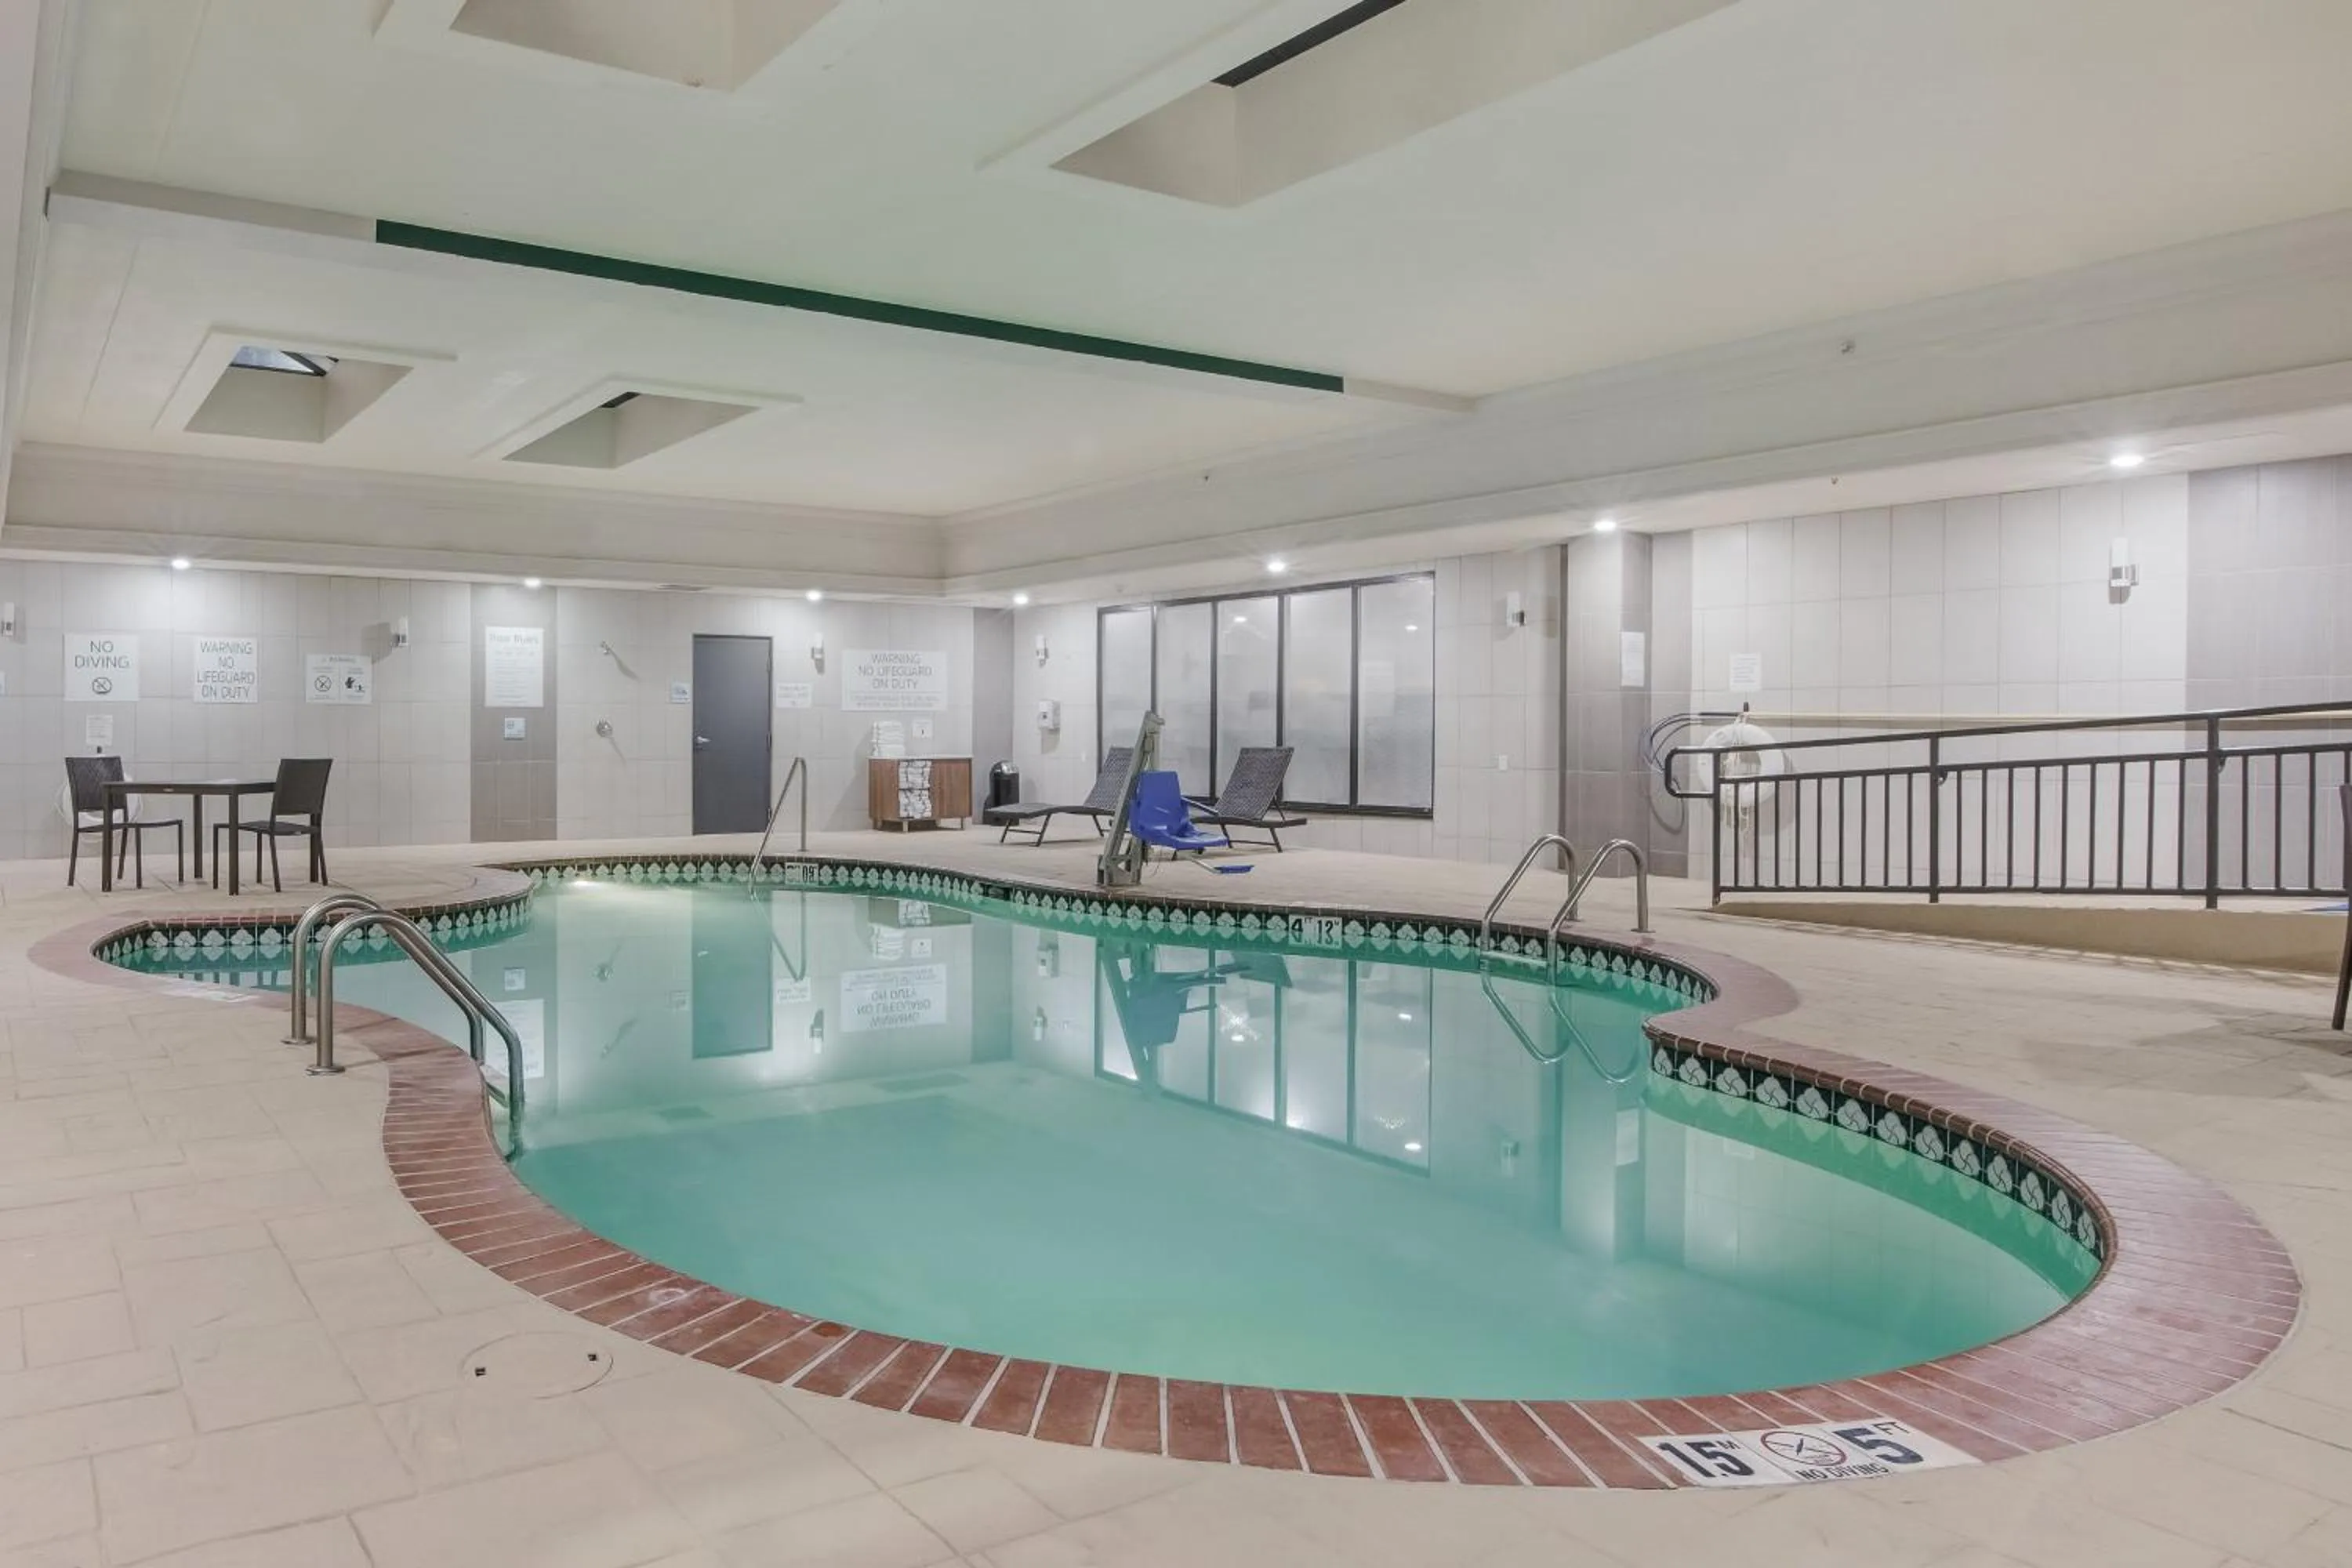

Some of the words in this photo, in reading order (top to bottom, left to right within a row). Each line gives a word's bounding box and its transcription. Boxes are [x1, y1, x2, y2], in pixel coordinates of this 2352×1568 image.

[89, 640, 114, 653] NO
[200, 641, 253, 654] WARNING
[74, 655, 130, 669] DIVING
[219, 655, 234, 669] NO
[871, 653, 923, 665] WARNING
[197, 670, 256, 684] LIFEGUARD
[858, 664, 874, 677] NO
[877, 665, 932, 677] LIFEGUARD
[872, 677, 889, 689] ON
[891, 677, 919, 690] DUTY
[201, 684, 217, 699] ON
[221, 686, 251, 699] DUTY
[1291, 918, 1303, 938] 4
[1871, 1421, 1911, 1436] FT
[1832, 1427, 1924, 1465] 5
[1795, 1468, 1828, 1480] NO
[1826, 1461, 1889, 1479] DIVING
